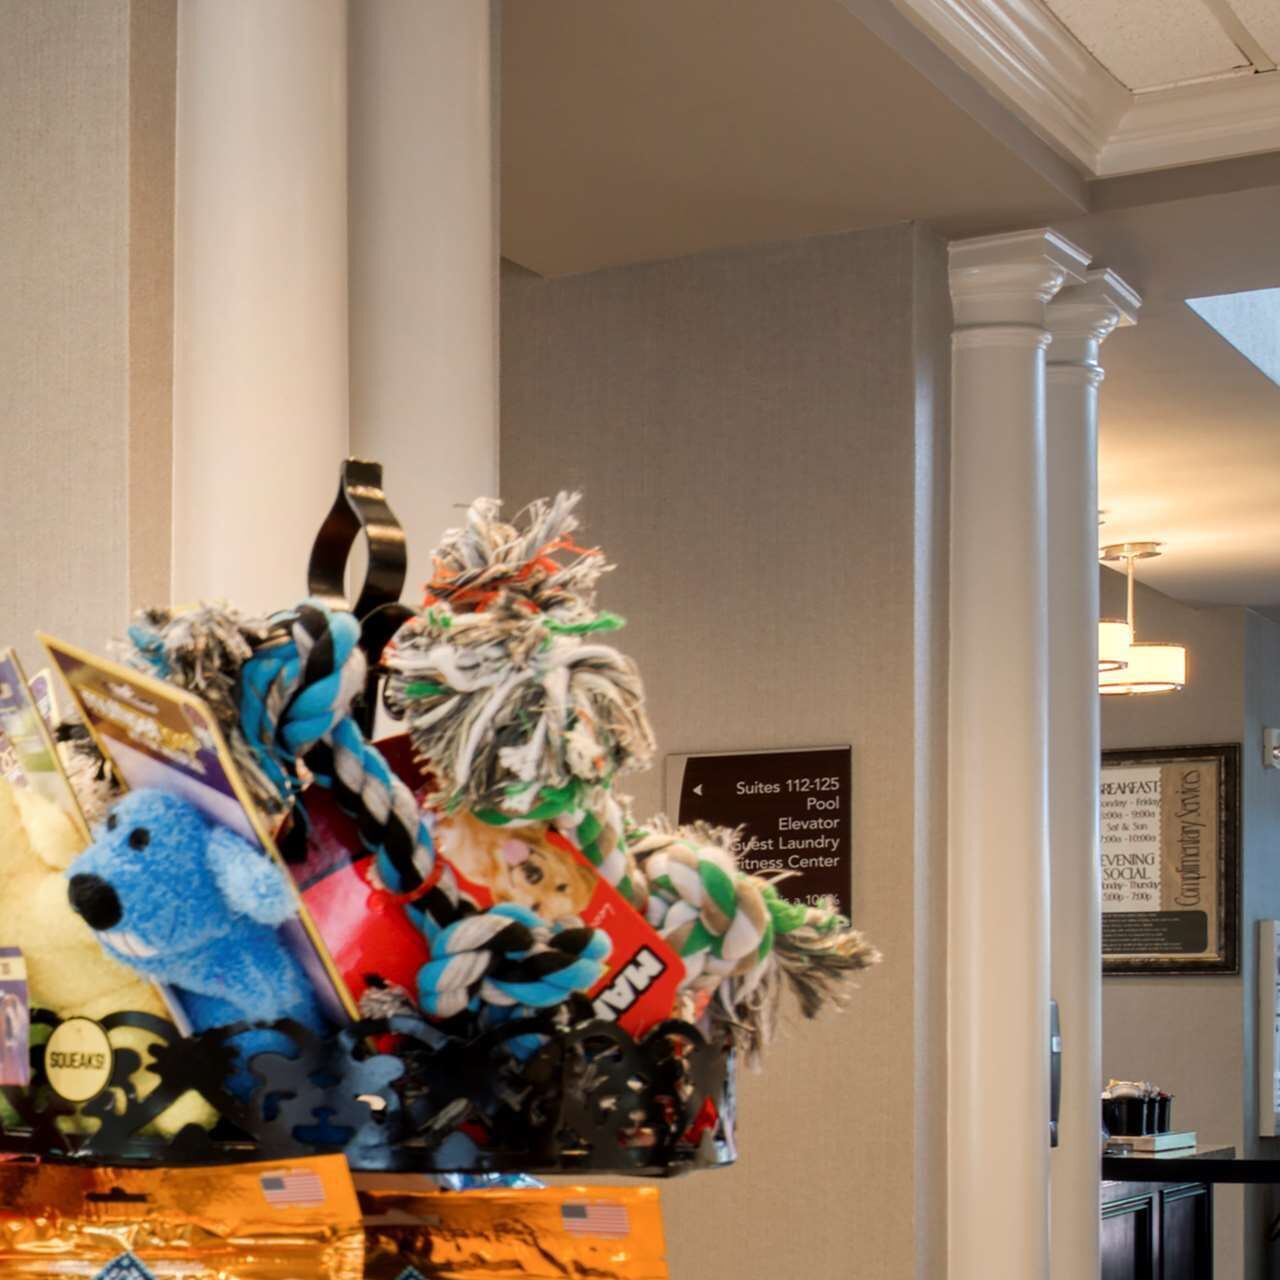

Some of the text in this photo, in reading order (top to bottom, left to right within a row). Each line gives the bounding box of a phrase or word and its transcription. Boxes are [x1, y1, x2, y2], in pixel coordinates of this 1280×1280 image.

[736, 776, 840, 796] Suites 112-125
[806, 796, 840, 811] Pool
[1101, 798, 1128, 809] onday
[778, 816, 840, 831] Elevator
[778, 835, 840, 852] Laundry
[736, 854, 840, 870] itness Center
[1103, 867, 1152, 881] SOCIAL
[48, 1052, 107, 1070] SQUEAKS!
